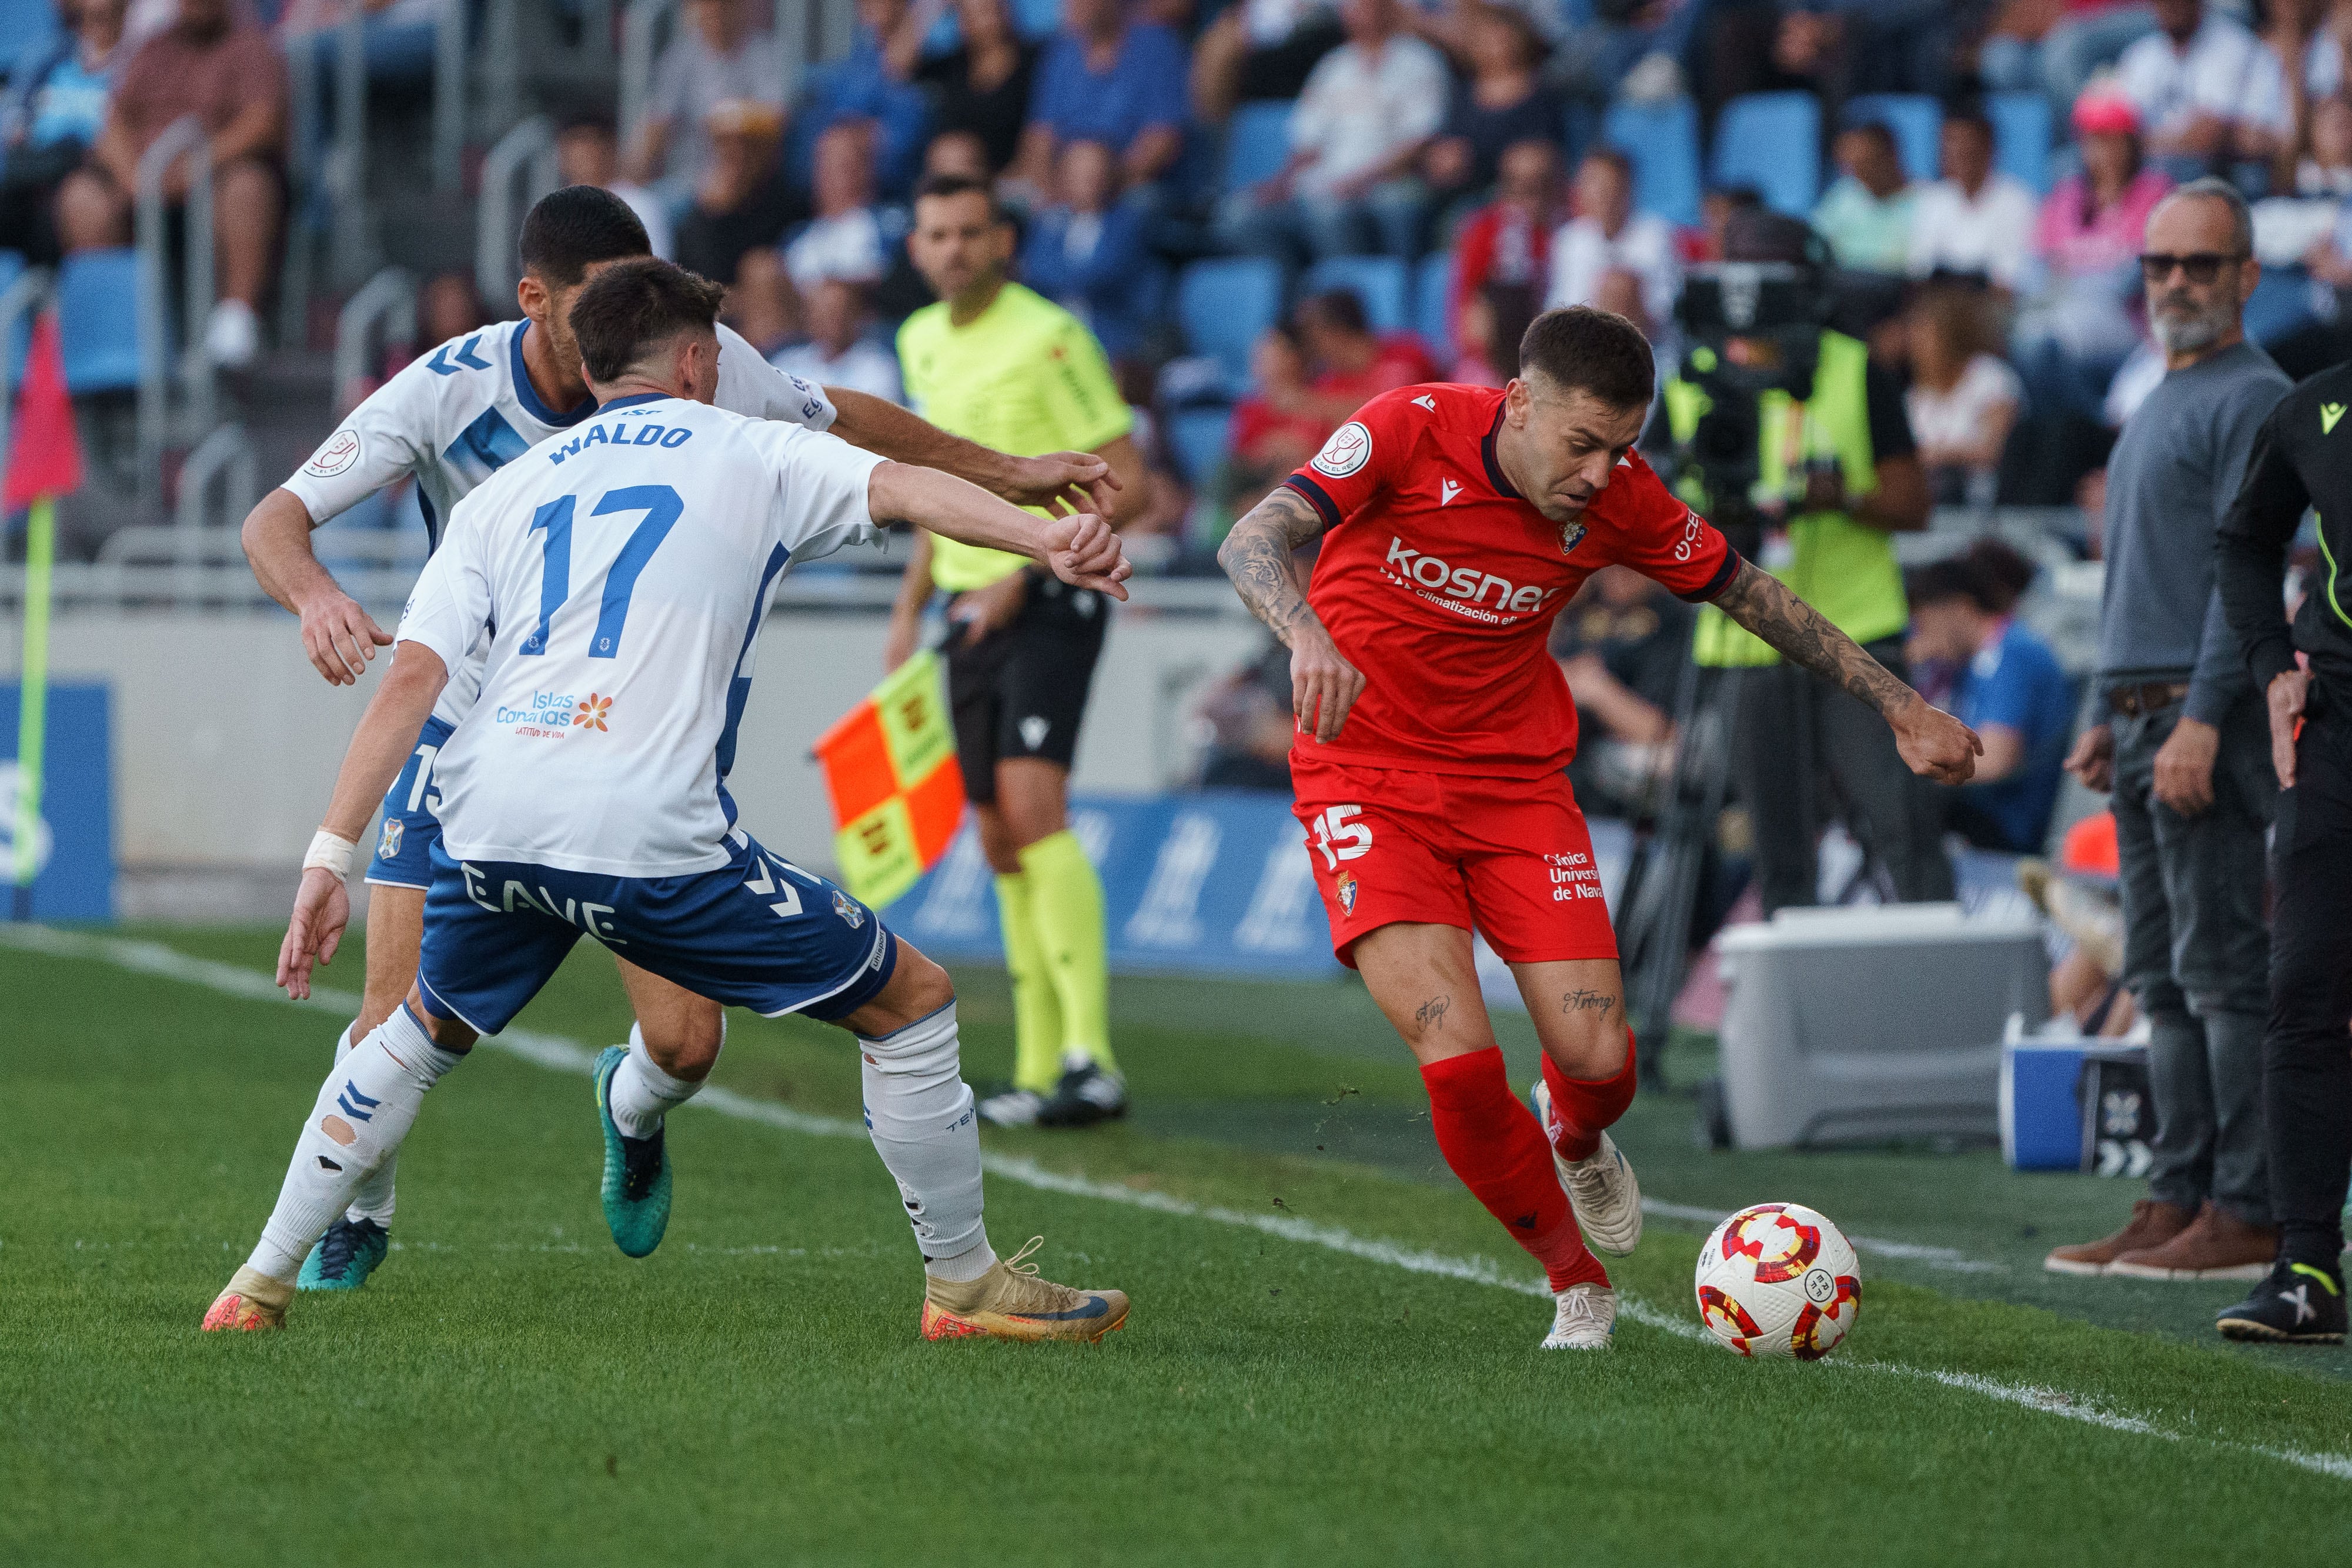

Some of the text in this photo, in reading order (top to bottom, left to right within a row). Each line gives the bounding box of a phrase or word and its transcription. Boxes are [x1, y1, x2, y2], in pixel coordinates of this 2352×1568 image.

[549, 423, 693, 466] WALDO
[1342, 462, 1354, 471] REY
[519, 485, 684, 658] 17
[1415, 589, 1499, 624] Climatización
[532, 691, 574, 709] Islas
[496, 706, 570, 727] Canarias
[516, 727, 541, 737] LATITUD
[552, 731, 564, 739] VIDA
[1313, 805, 1372, 871] 15
[1553, 885, 1572, 901] de
[873, 931, 885, 967] uhlsport
[1563, 989, 1616, 1021] Strong
